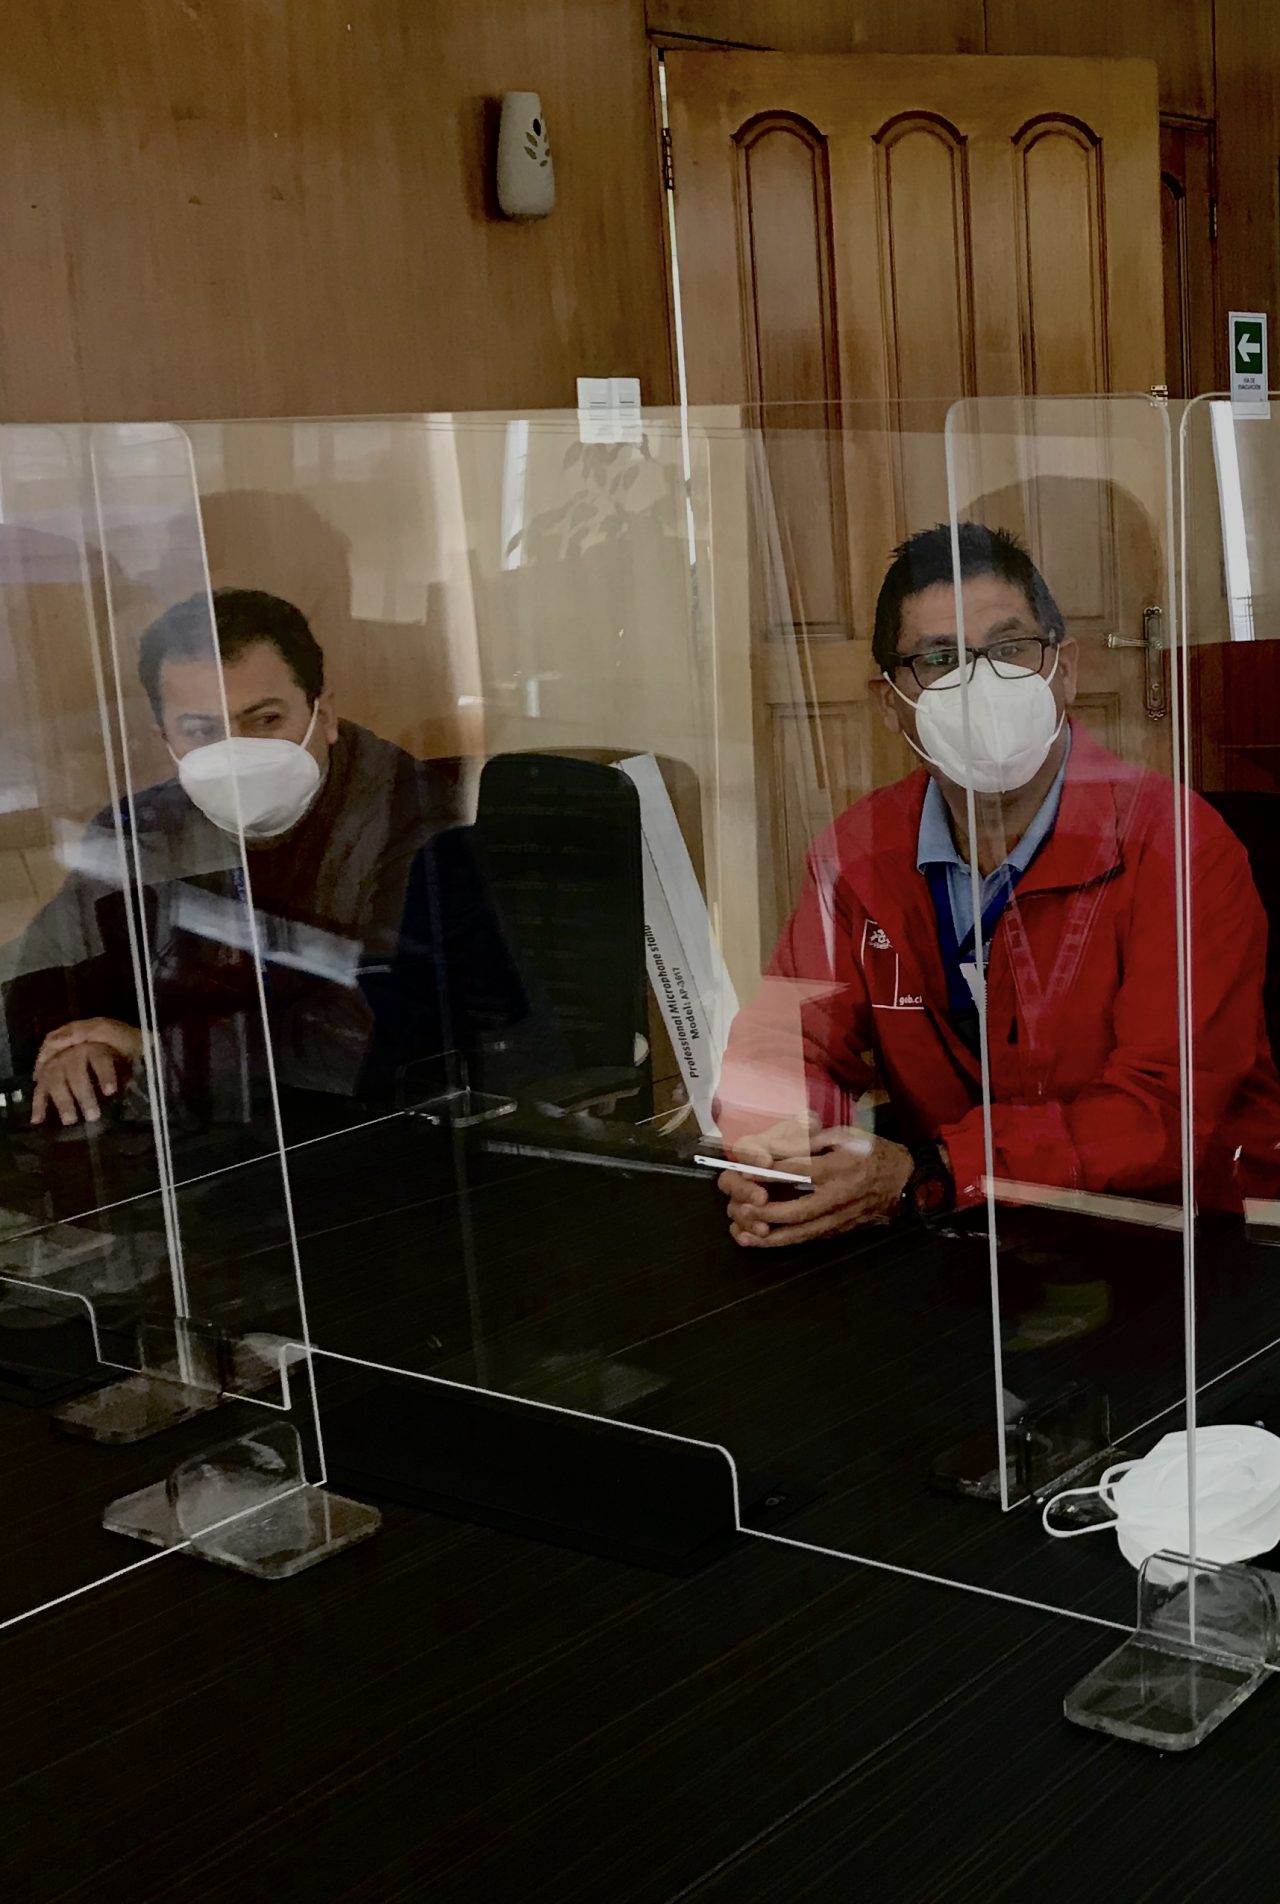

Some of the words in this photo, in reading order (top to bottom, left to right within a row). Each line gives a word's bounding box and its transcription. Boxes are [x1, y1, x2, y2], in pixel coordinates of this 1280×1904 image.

[653, 953, 680, 1014] Microphone
[671, 1015, 700, 1078] Professional
[682, 1001, 700, 1040] Model:
